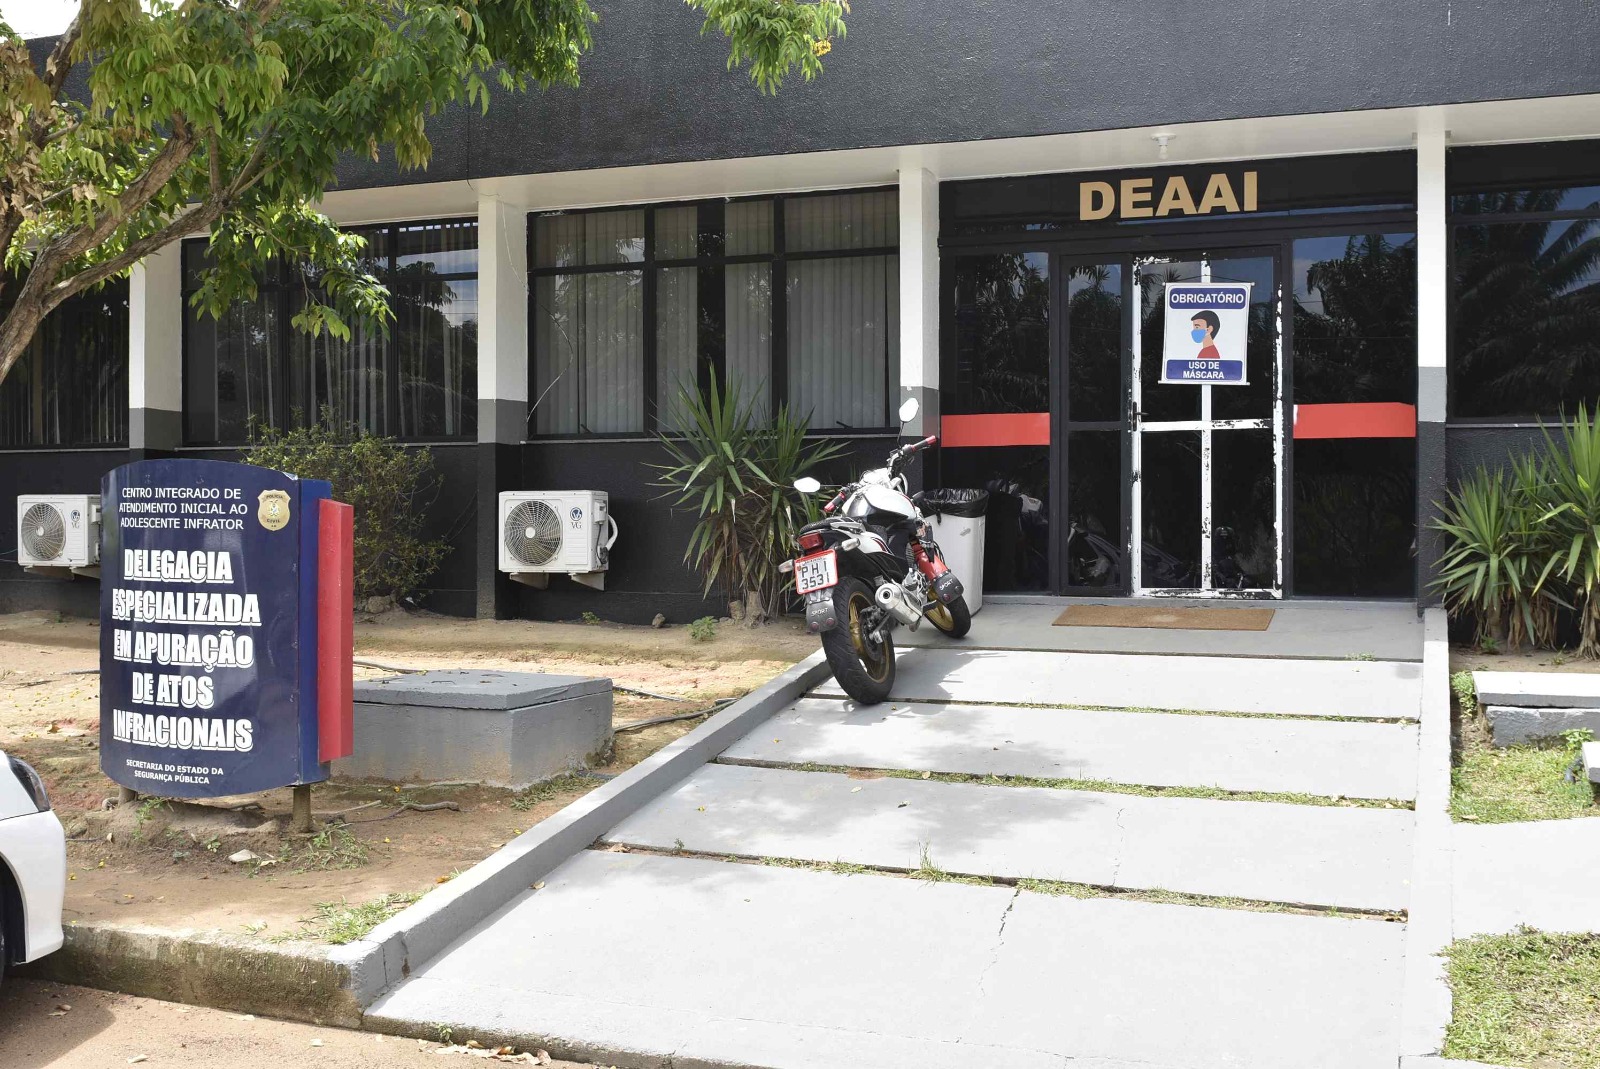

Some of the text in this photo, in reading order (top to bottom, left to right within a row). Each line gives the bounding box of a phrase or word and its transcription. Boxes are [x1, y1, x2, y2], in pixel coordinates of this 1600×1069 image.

[1079, 171, 1258, 221] DEAAI
[1171, 291, 1244, 304] OBRIGATÓRIO
[1182, 369, 1225, 379] MÁSCARA
[1188, 361, 1220, 370] USO DE
[122, 487, 242, 499] CENTRO INTEGRADO DE
[119, 502, 248, 515] ATENDIMENTO INICIAL AO
[120, 518, 245, 530] ADOLESCENTE INFRATOR
[123, 548, 234, 584] DELEGACIA
[801, 560, 827, 578] PHI
[801, 572, 830, 590] 3531
[112, 588, 262, 627] ESPECIALIZADA
[811, 607, 828, 617] SPORT
[113, 628, 254, 673] EM APURAÇÃO
[131, 671, 215, 709] DE ATOS
[112, 708, 254, 752] INFRACIONAIS
[126, 758, 224, 776] SECRETARIA DO ESTADO DA
[134, 770, 210, 784] SEGURANÇA PÚBLICA
